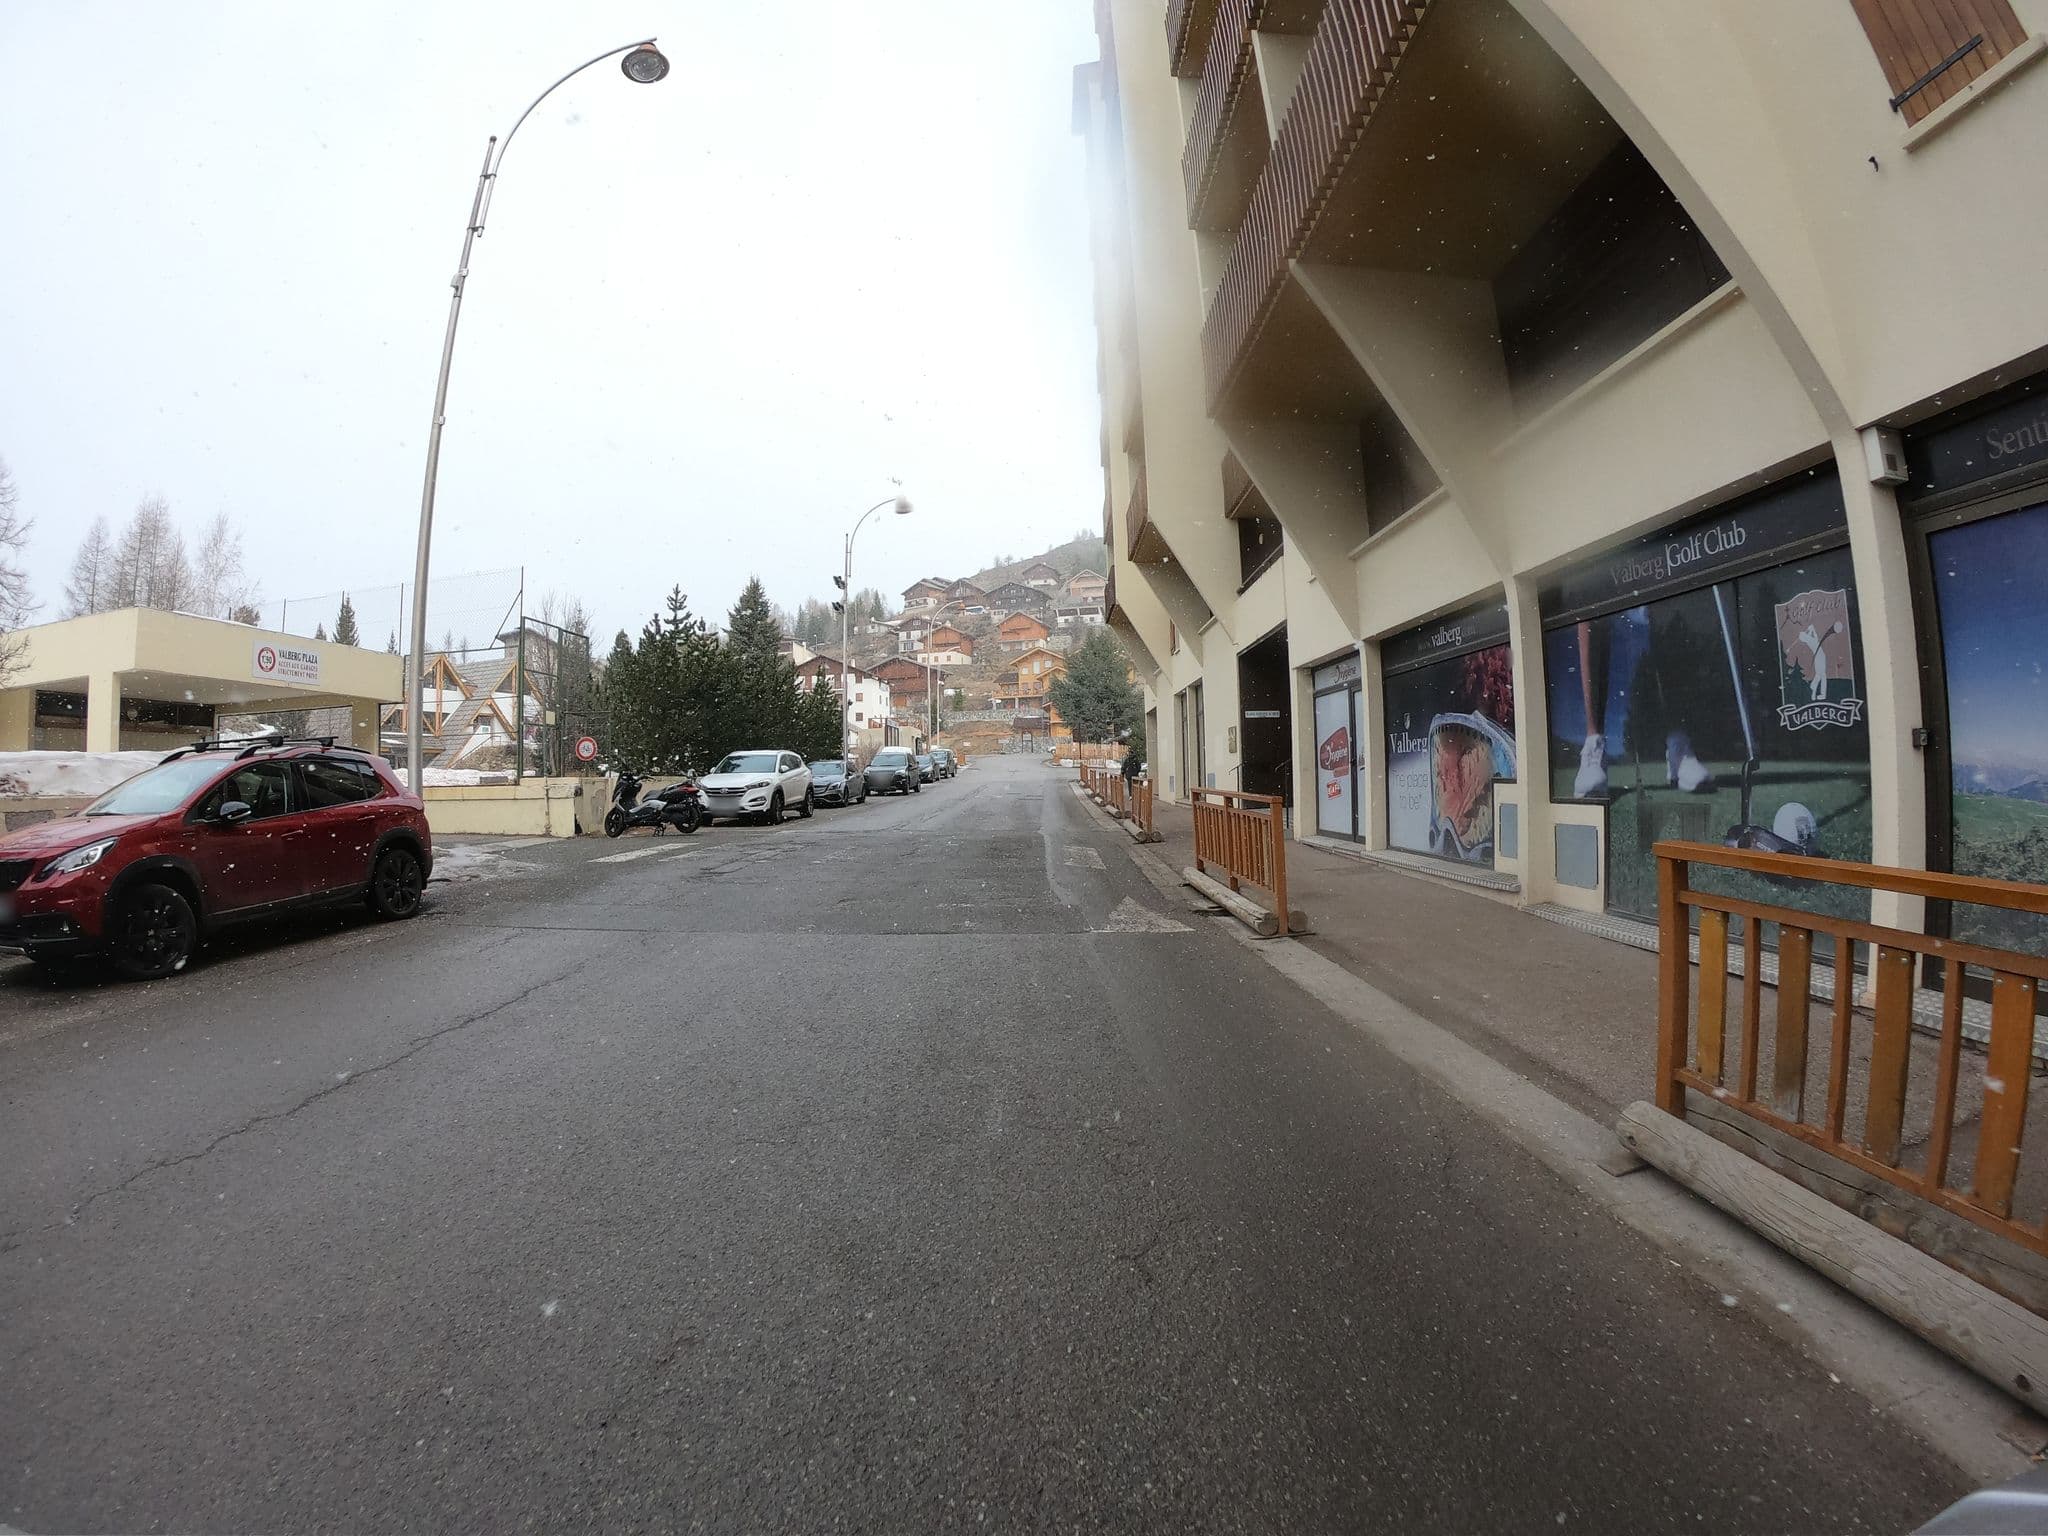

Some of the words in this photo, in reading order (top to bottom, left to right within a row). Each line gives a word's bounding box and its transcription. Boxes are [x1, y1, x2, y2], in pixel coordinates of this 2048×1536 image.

[1610, 556, 1665, 584] Valberg
[1667, 533, 1702, 568] Golf
[1703, 520, 1745, 555] Club
[279, 649, 301, 661] VALBERG
[302, 653, 318, 665] PLAZA
[1792, 707, 1848, 725] VALBERG
[1389, 732, 1428, 754] Valberg
